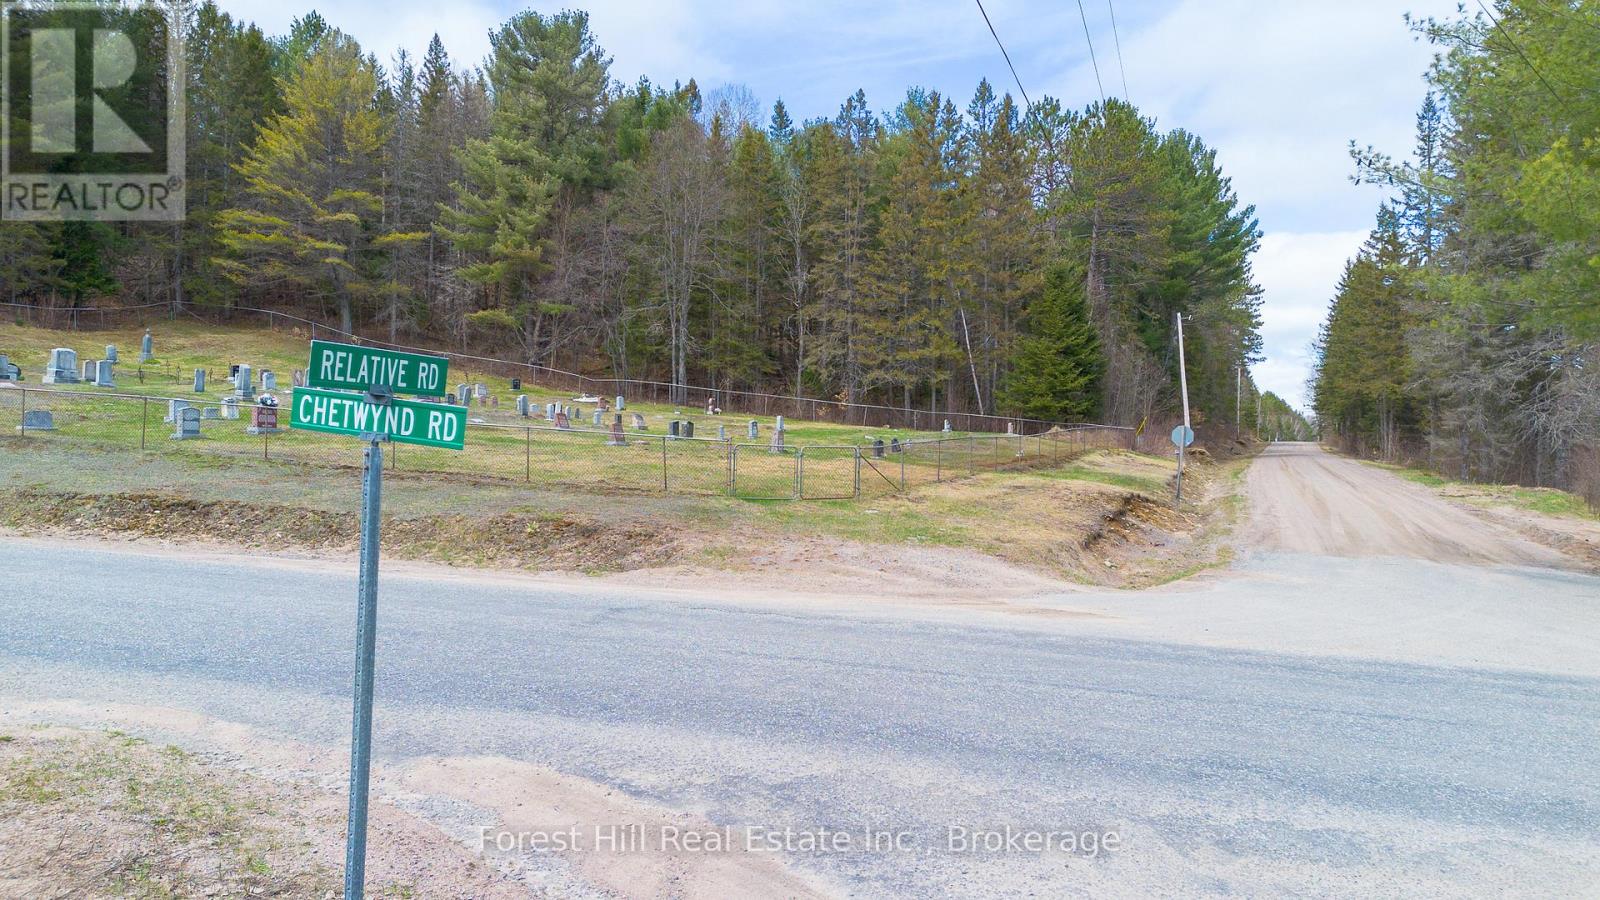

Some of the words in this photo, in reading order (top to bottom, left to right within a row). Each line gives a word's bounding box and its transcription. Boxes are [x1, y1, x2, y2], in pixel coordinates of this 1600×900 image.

[320, 350, 408, 388] RELATIVE
[417, 362, 439, 390] RD
[299, 395, 414, 436] CHETWYND
[427, 411, 457, 441] RD
